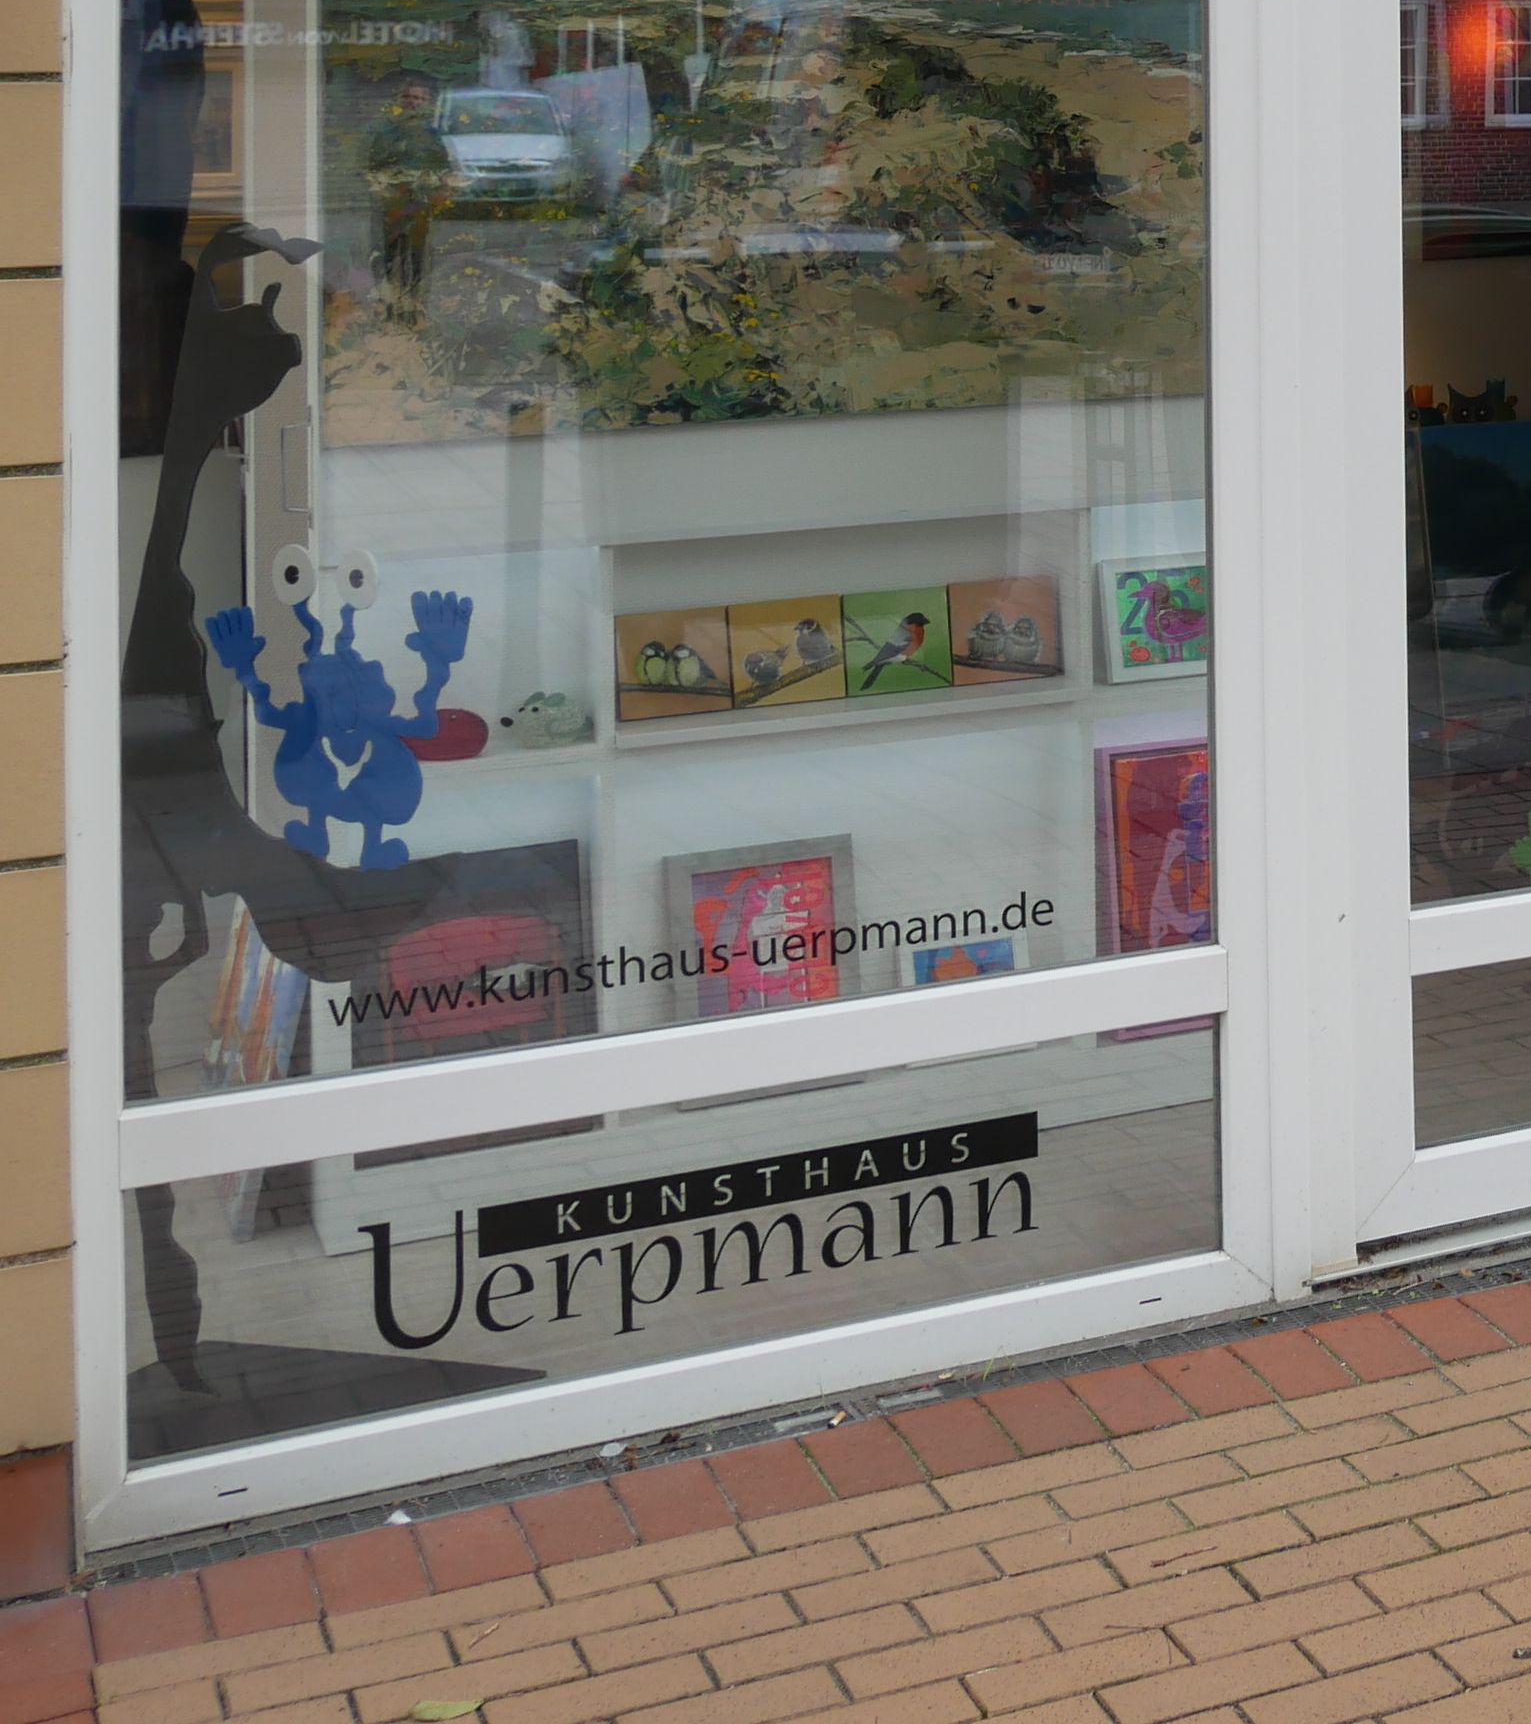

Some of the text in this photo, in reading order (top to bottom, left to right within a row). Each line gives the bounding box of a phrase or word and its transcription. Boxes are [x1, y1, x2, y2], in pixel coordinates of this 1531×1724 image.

[327, 890, 1056, 1029] www.kunsthaus-uerpmann.de
[555, 1131, 973, 1235] KUNSTHAUS
[357, 1167, 1040, 1351] Uerpmann
